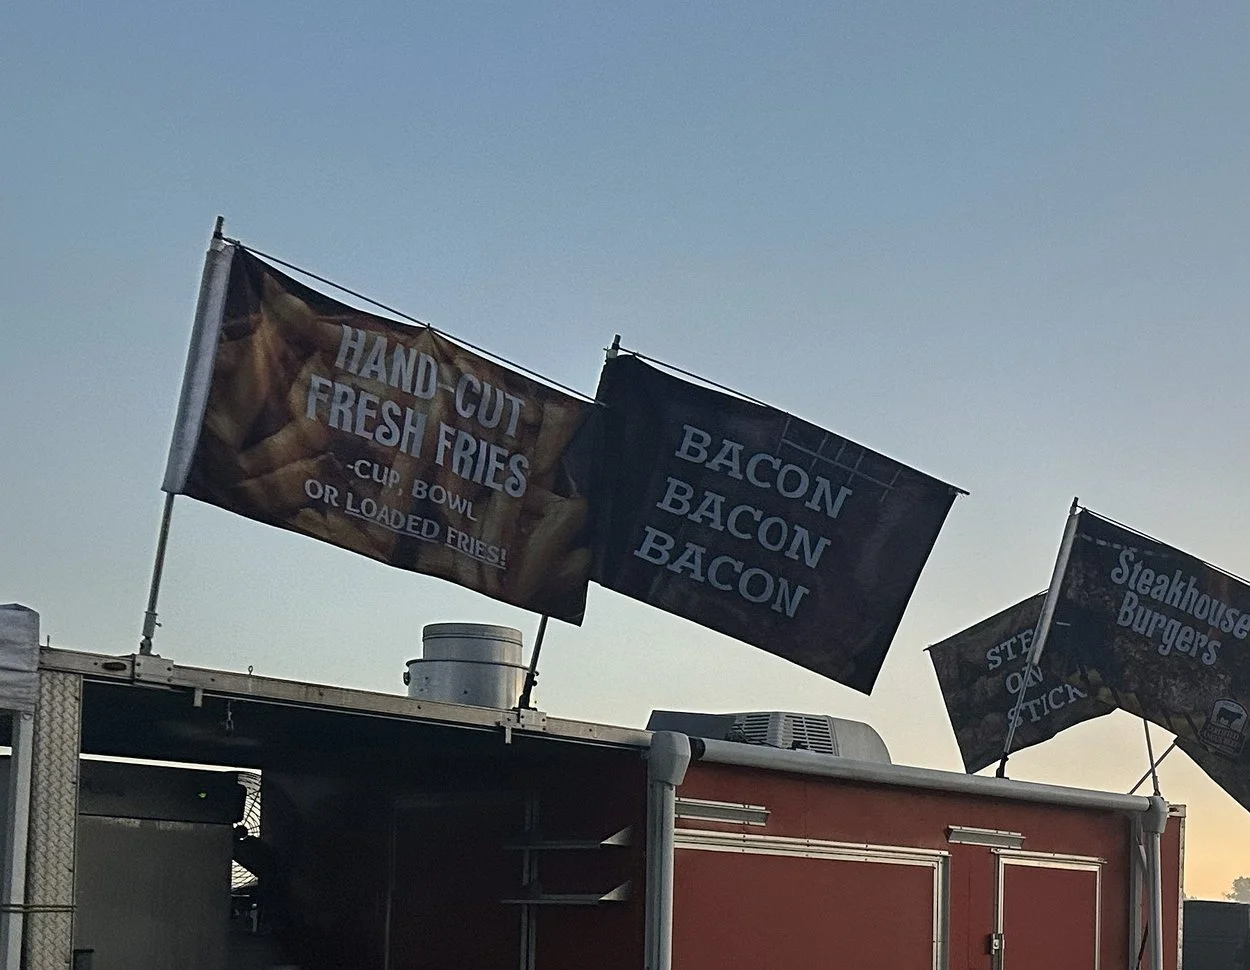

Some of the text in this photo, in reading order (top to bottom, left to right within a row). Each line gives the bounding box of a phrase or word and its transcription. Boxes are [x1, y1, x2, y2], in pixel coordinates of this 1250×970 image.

[305, 374, 530, 498] FRESH FRIES
[675, 424, 852, 519] BACON
[304, 479, 508, 569] OR LOADED FRIES!
[411, 480, 478, 522] BOWL
[656, 476, 831, 569] BACON
[634, 526, 810, 619] BACON
[986, 629, 1034, 670] STE
[1117, 591, 1222, 666] Burgers
